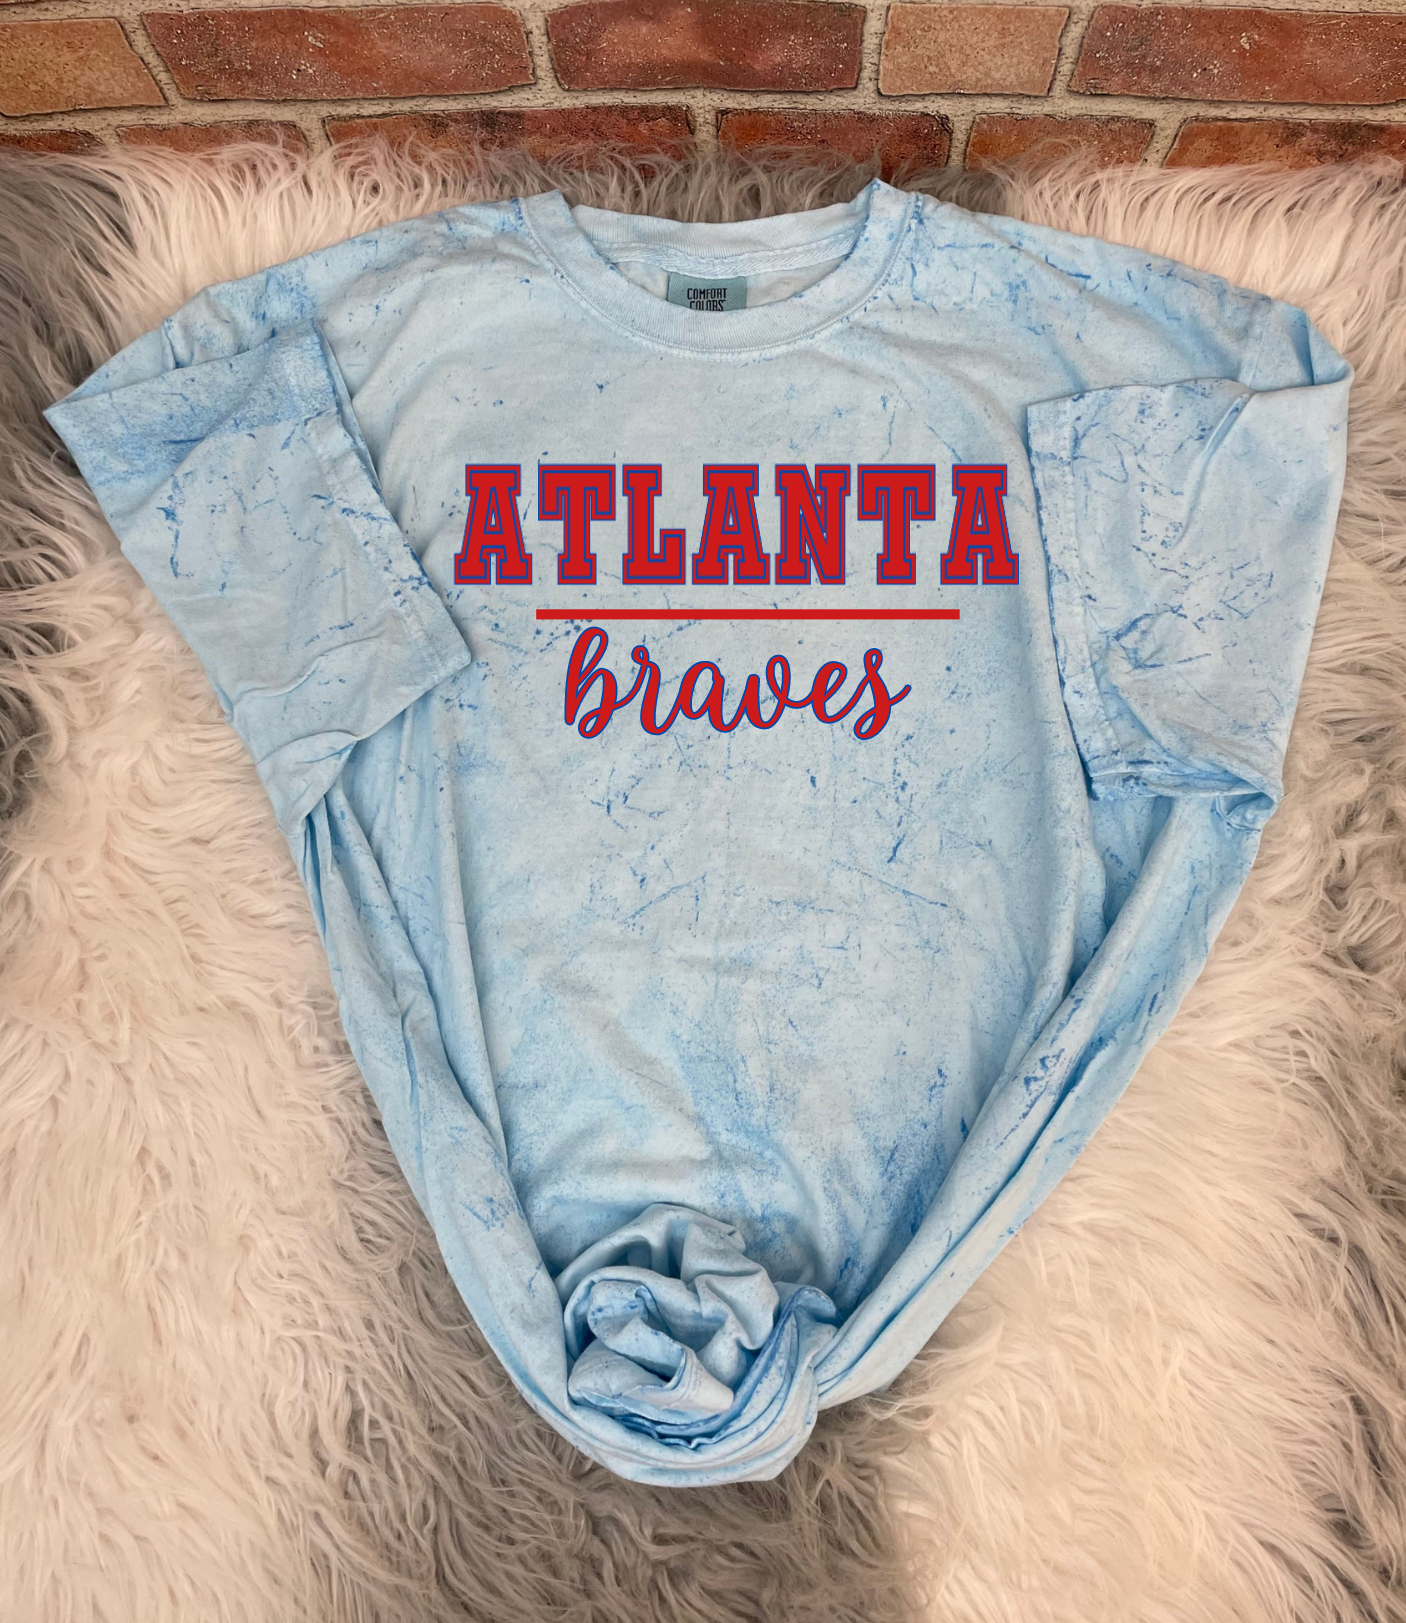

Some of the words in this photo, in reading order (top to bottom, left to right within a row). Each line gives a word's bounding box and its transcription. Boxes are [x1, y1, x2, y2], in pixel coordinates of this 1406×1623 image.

[687, 288, 727, 300] COMFORT
[454, 464, 1020, 585] ATLANTA
[565, 626, 912, 740] braves
